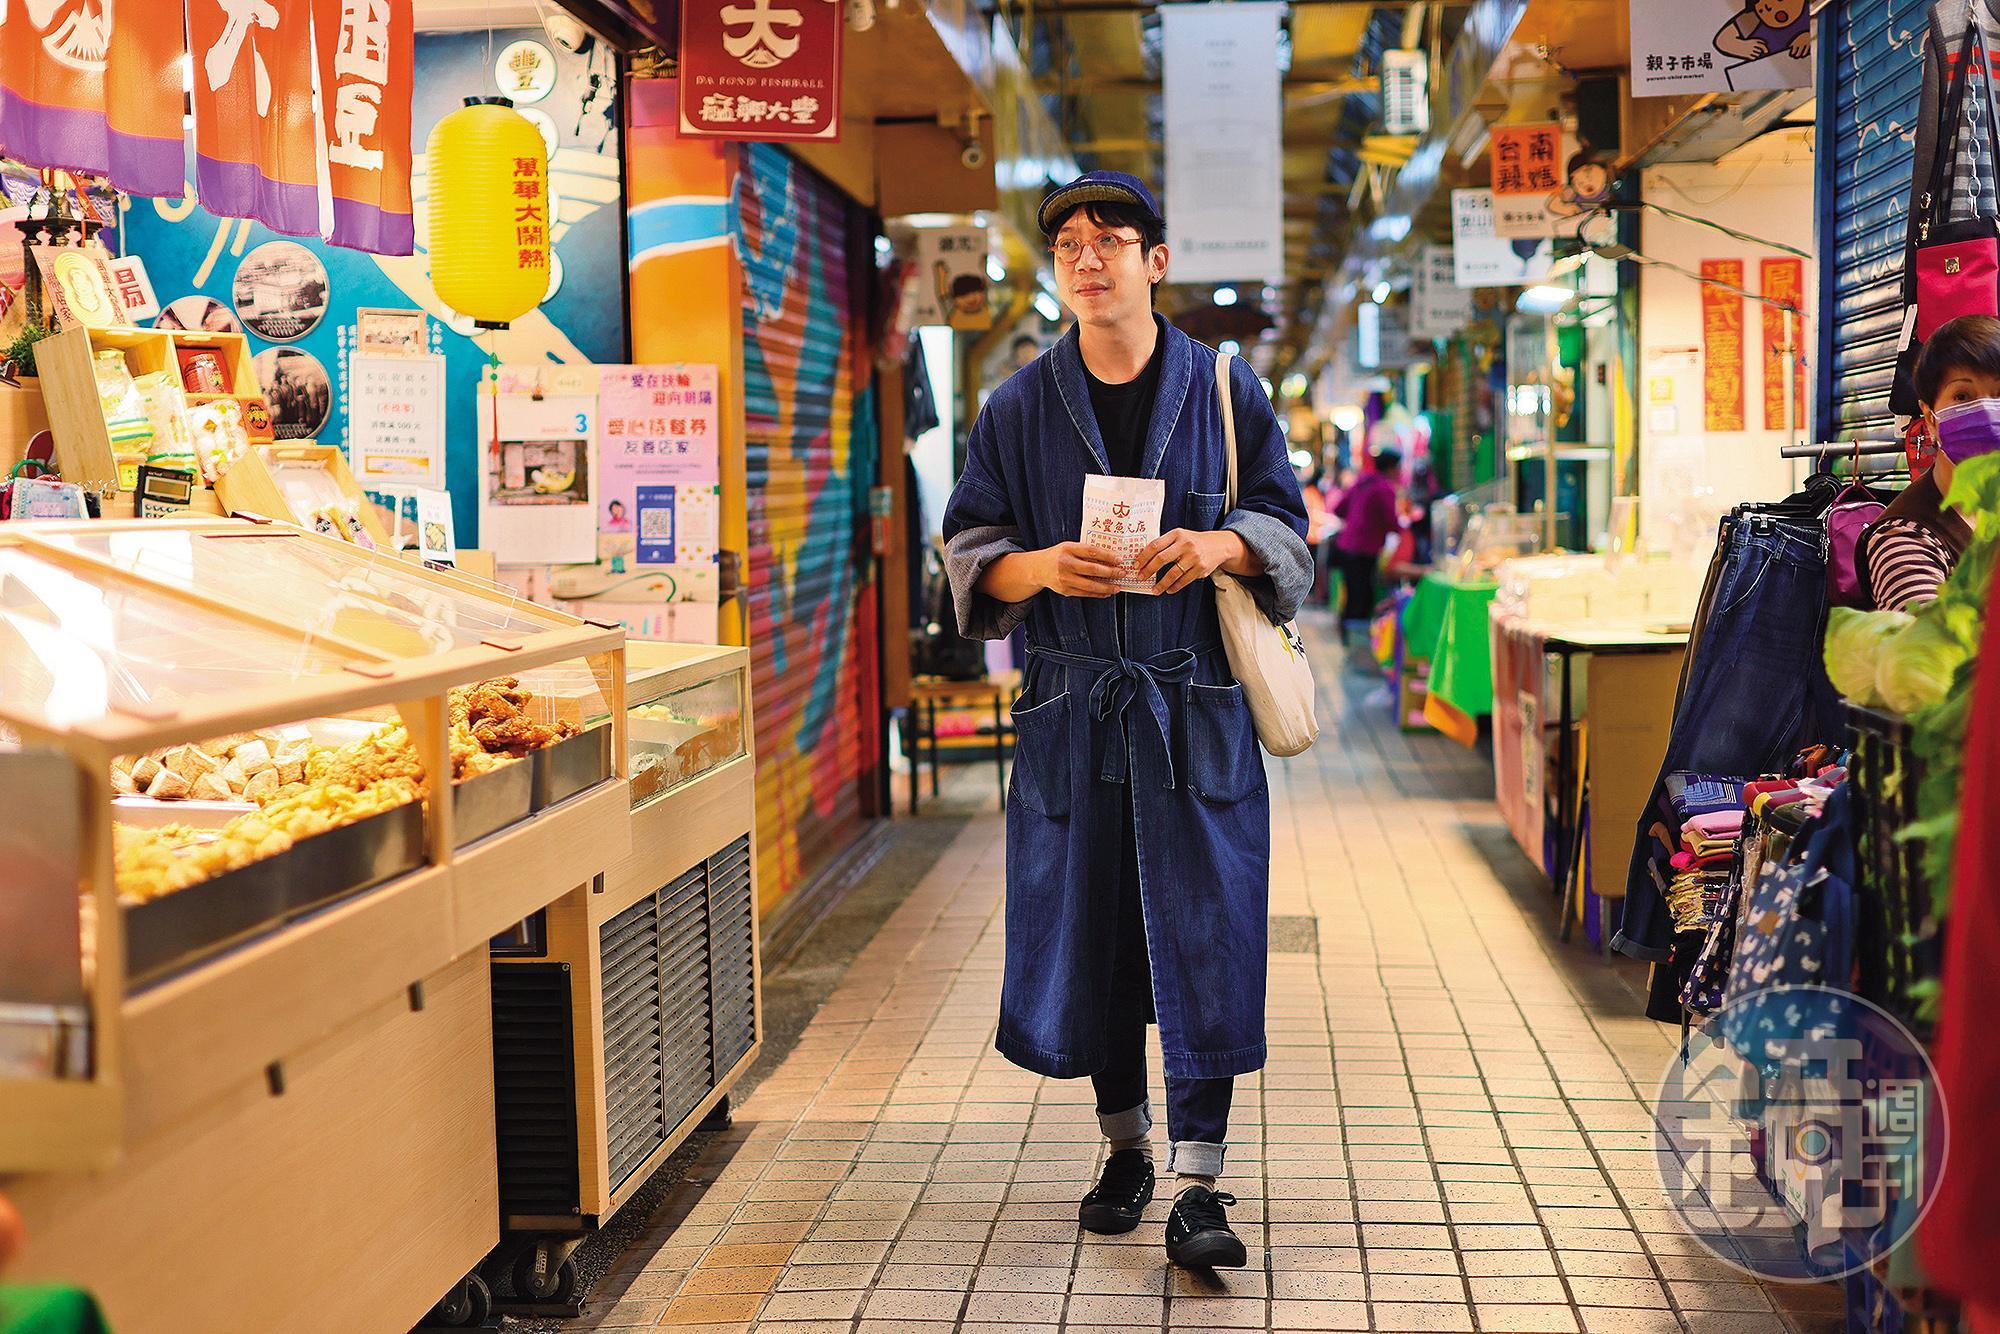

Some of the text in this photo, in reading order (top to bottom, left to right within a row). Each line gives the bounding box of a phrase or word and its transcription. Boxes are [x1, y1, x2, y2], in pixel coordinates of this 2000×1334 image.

[1646, 52, 1713, 71] 親子市場
[512, 156, 545, 270] 萬華大鬧熱
[575, 413, 588, 433] 3
